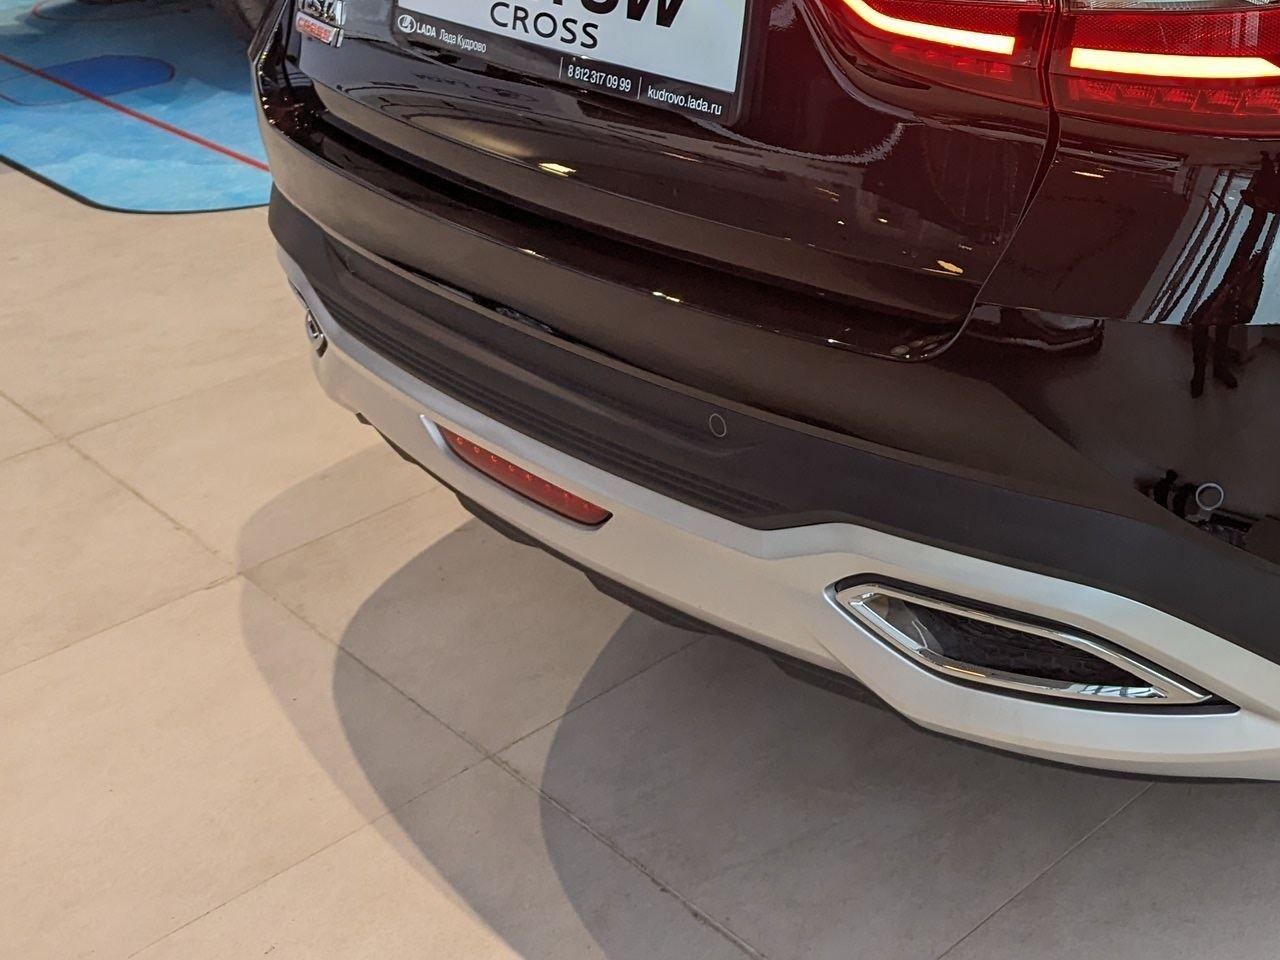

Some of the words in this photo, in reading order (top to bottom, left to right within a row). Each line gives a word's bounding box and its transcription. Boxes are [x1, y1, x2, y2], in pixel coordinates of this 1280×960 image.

[416, 22, 437, 38] LADA
[490, 2, 600, 50] CROSS
[438, 29, 457, 44] Лада
[457, 34, 487, 53] Кудрово
[567, 64, 574, 77] 8
[575, 66, 590, 81] 812
[590, 70, 606, 85] 317
[606, 75, 618, 89] 09
[619, 77, 632, 92] 99
[647, 85, 722, 115] kudrovo.lada.ru
